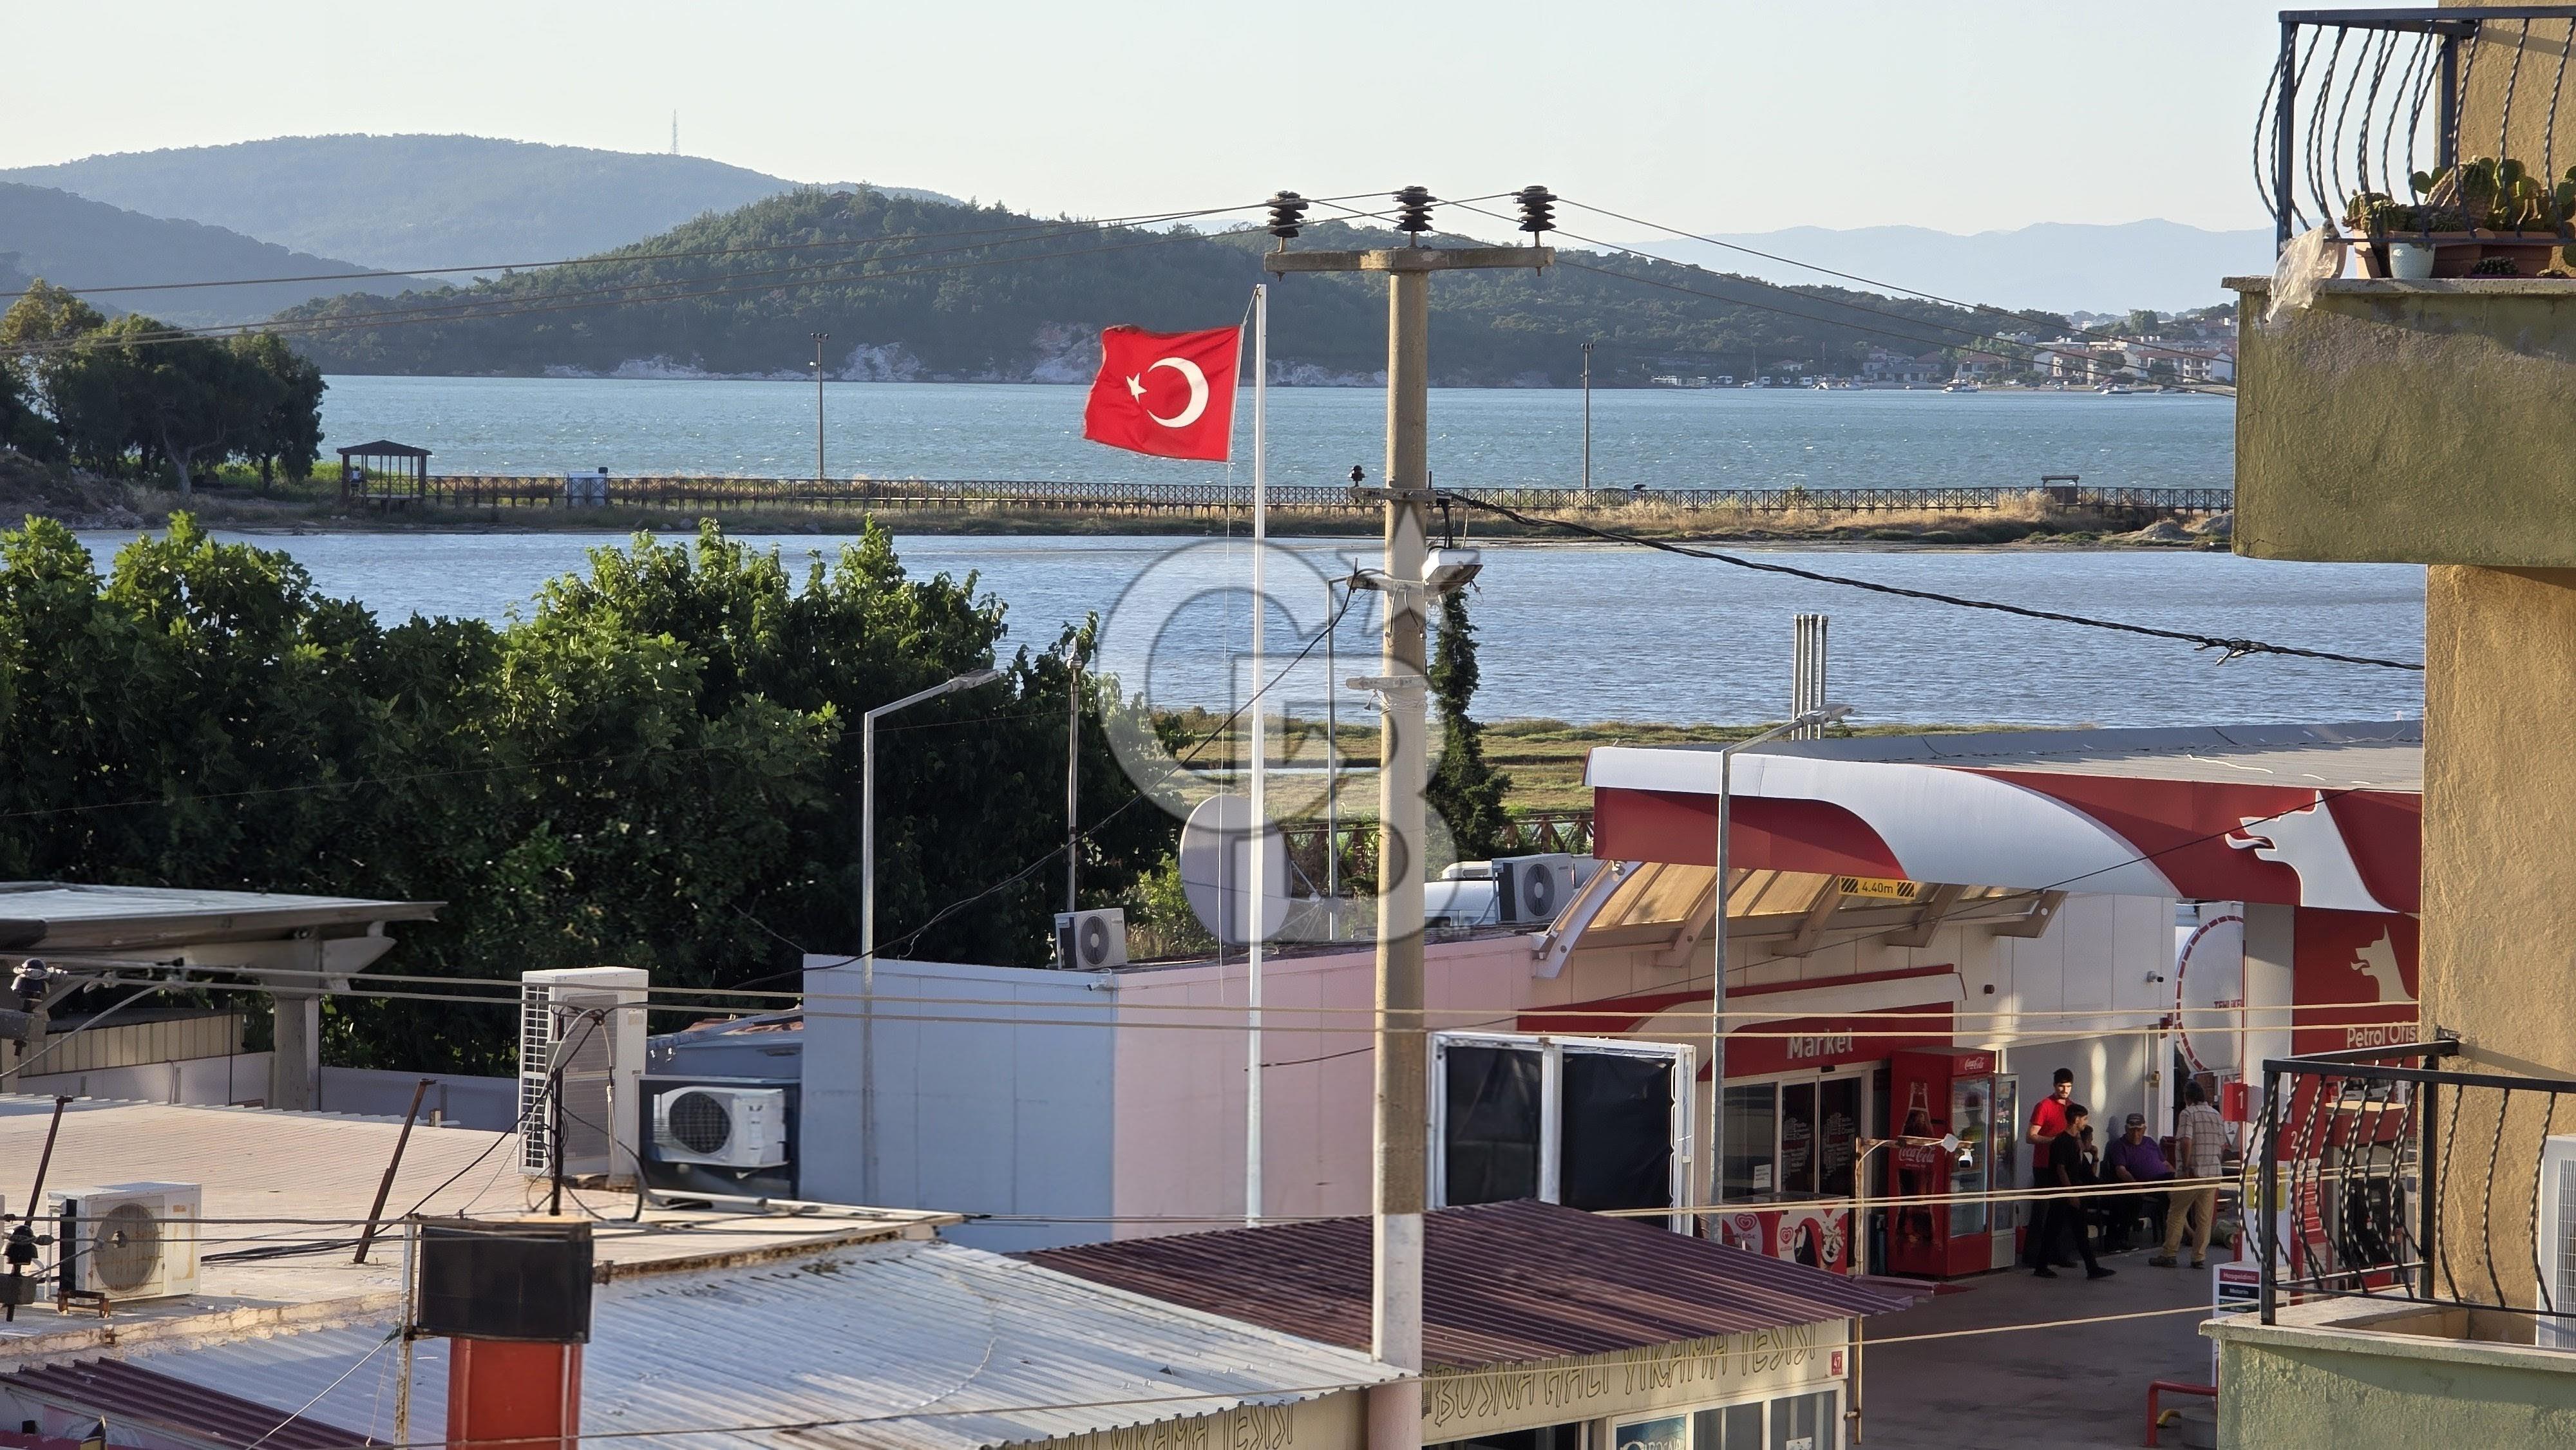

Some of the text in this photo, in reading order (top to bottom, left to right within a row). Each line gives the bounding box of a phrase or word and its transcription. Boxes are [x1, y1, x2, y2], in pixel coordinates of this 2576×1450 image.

[1862, 881, 1893, 894] 4.40m
[1787, 1027, 1853, 1059] Market
[2347, 1025, 2385, 1048] Petrol
[2238, 1091, 2244, 1109] 1
[2291, 1131, 2300, 1149] 2
[1435, 1362, 1536, 1427] BOSNA
[1624, 1334, 1728, 1395] YIKAMA
